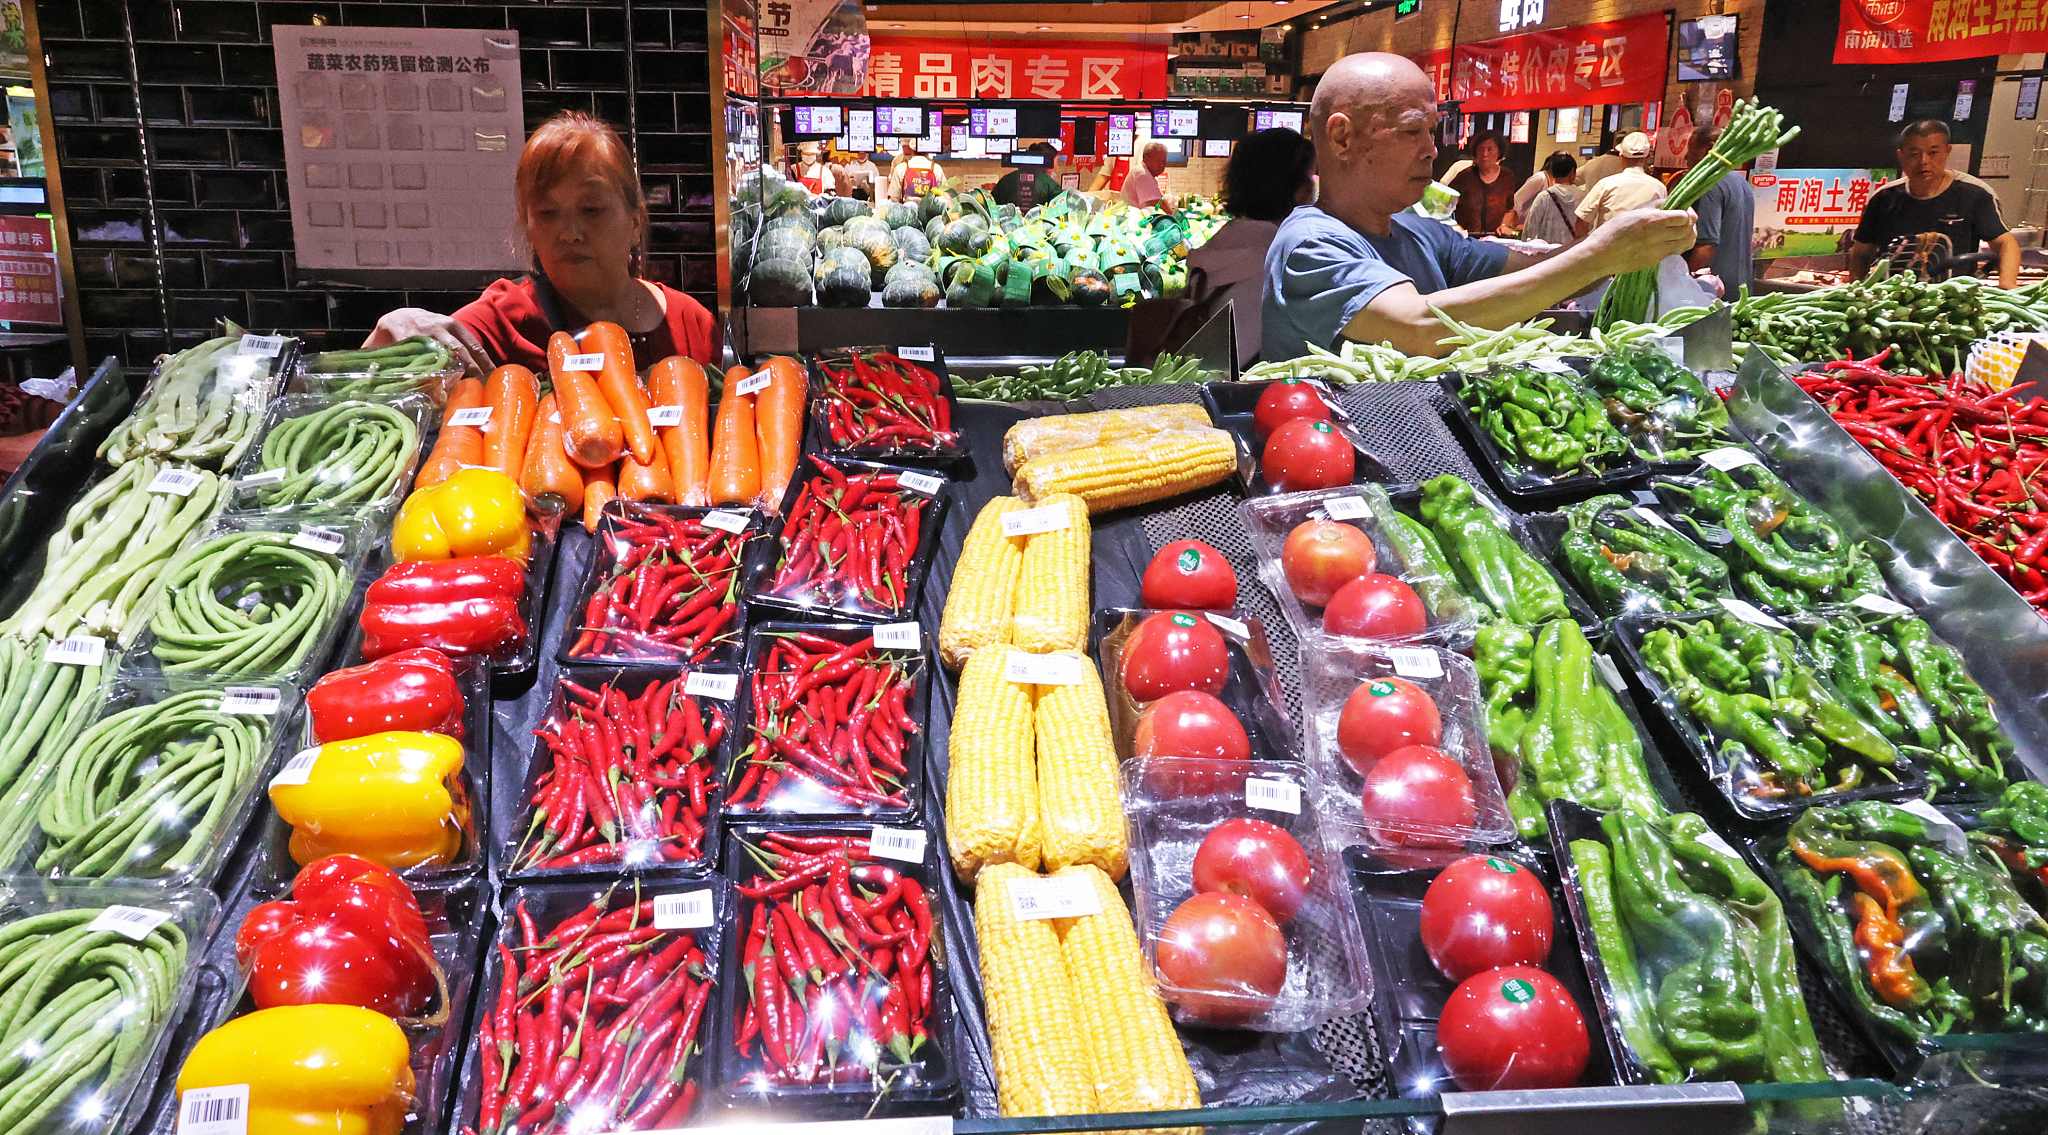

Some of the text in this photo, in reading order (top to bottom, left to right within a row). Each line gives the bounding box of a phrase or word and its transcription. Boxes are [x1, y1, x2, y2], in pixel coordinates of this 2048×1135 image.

[759, 0, 791, 26] 节
[1844, 28, 1913, 49] 雨润优选
[307, 53, 490, 74] 蔬菜农药残留检测公布
[863, 52, 1124, 99] 精品肉专区
[1776, 177, 1888, 213] 雨润土猪
